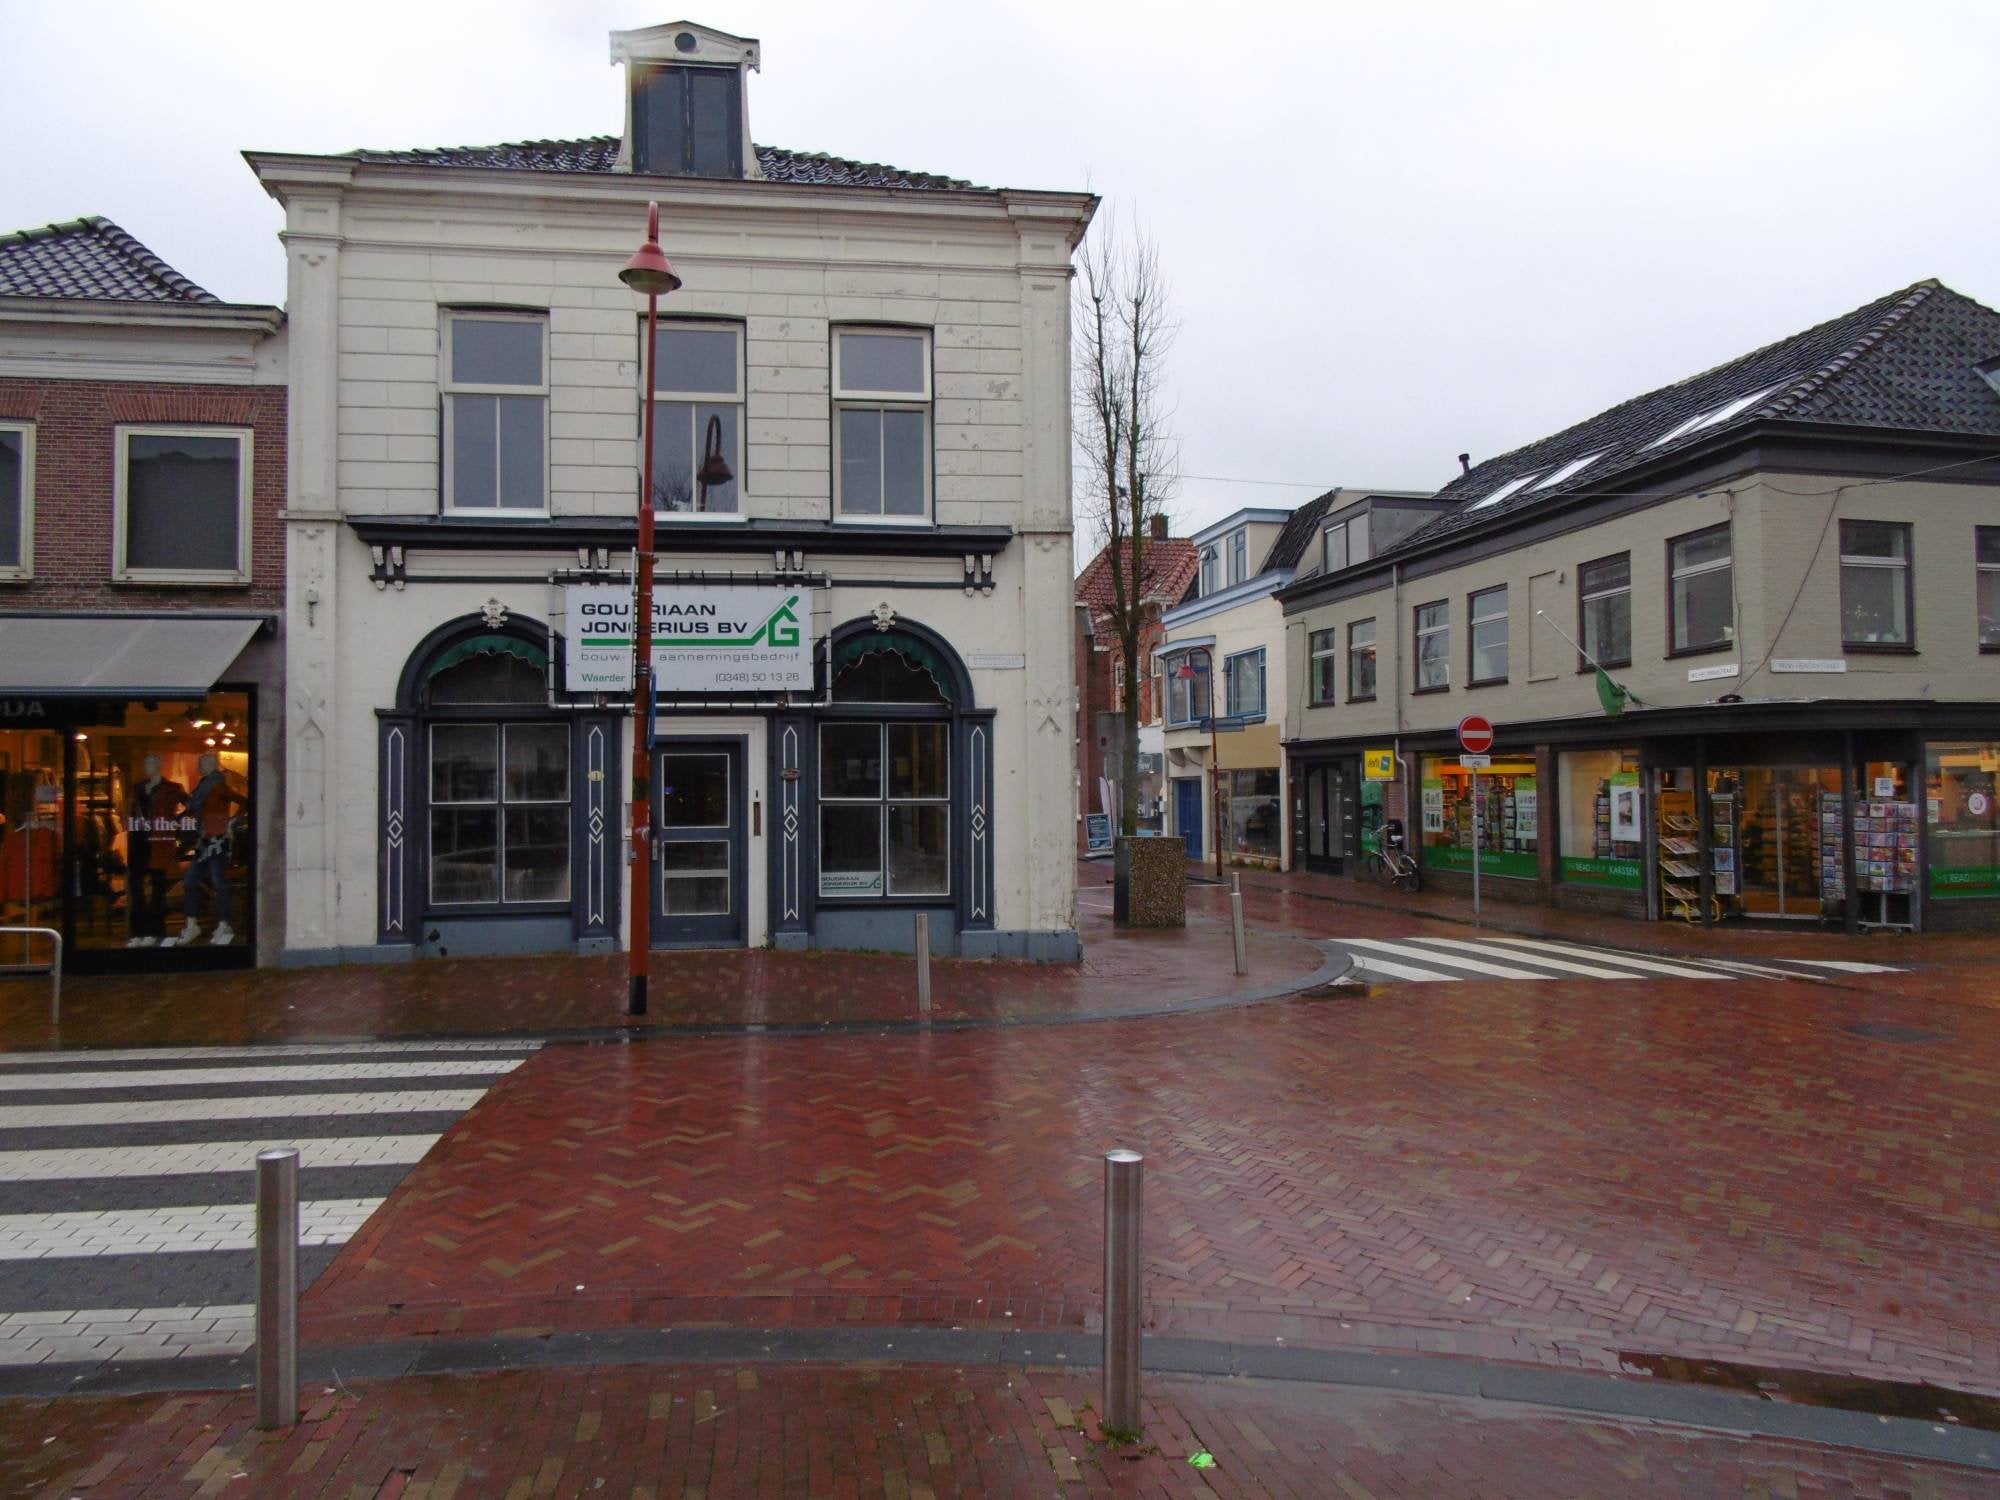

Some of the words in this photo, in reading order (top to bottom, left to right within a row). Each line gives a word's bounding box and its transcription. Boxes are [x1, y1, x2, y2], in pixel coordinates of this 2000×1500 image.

[581, 604, 716, 616] GOURIAAN
[717, 622, 748, 634] BV
[659, 652, 800, 663] aannemingsbedrijf
[581, 672, 626, 682] Waarder
[715, 672, 750, 683] (0348)
[752, 672, 767, 682] 50
[770, 672, 783, 682] 13
[0, 700, 46, 717] DA
[128, 816, 152, 832] It's
[155, 816, 178, 831] the
